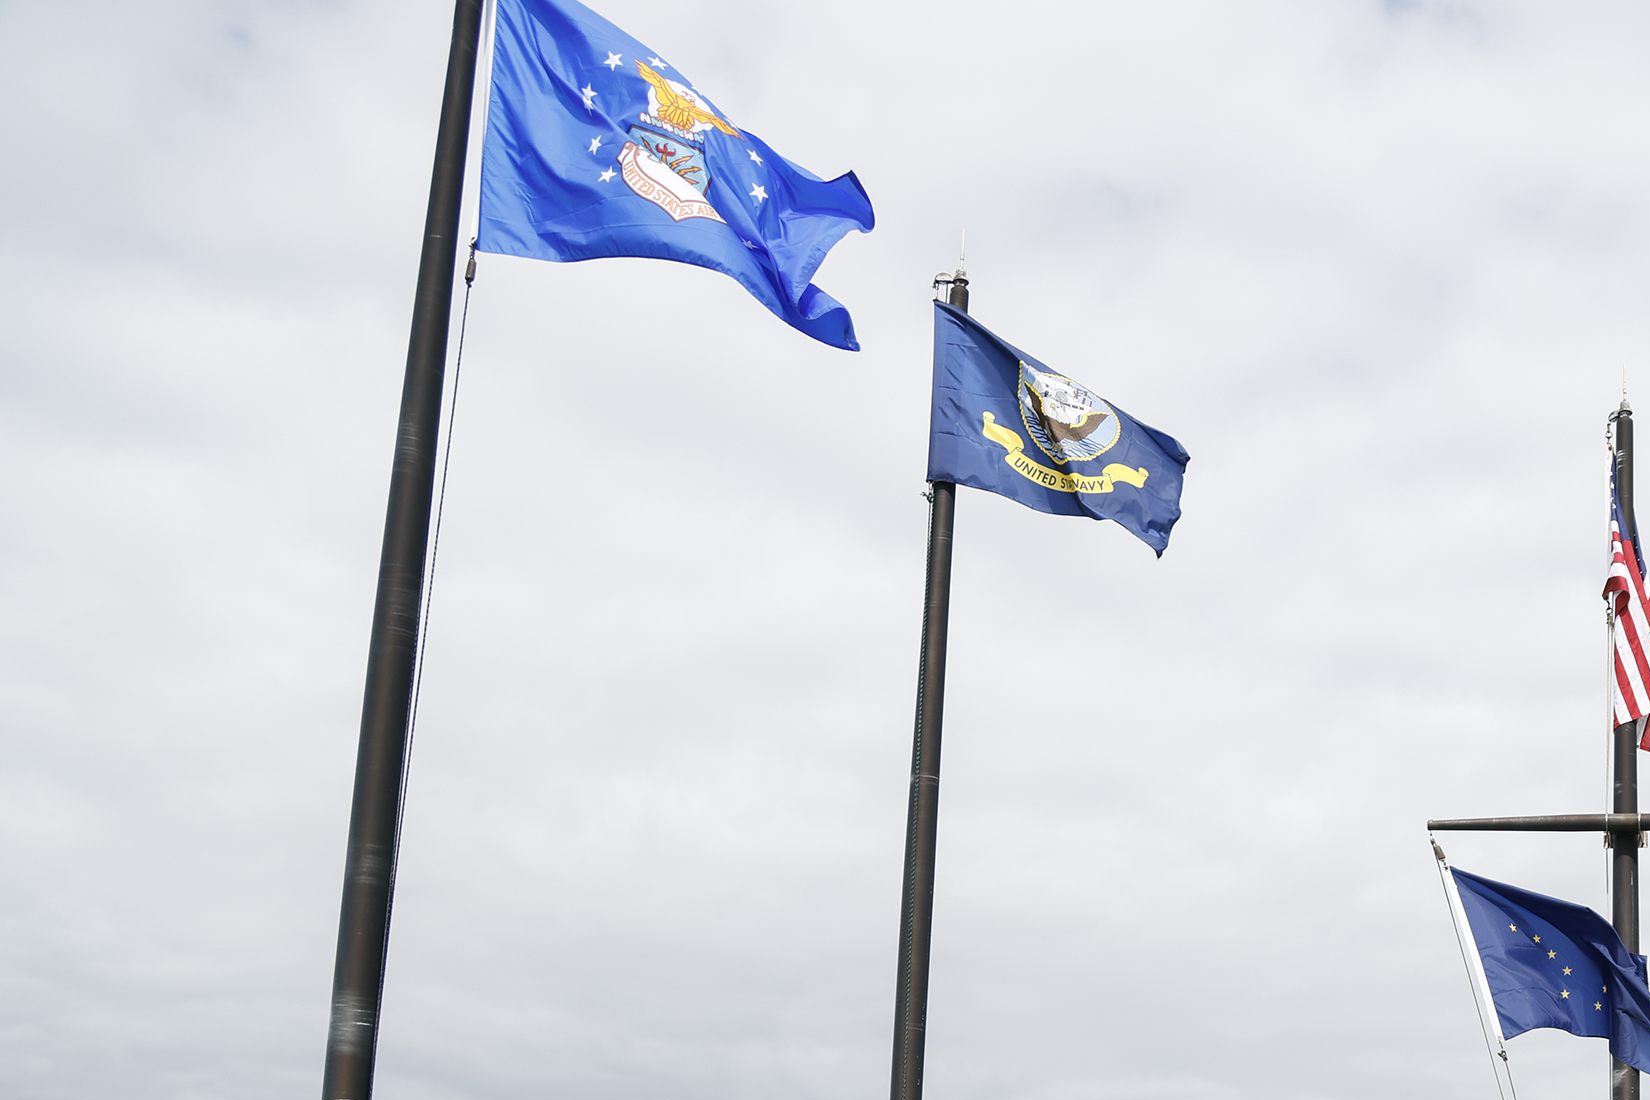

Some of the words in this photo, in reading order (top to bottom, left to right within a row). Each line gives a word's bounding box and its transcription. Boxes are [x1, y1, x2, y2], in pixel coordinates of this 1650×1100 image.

[623, 159, 655, 195] UNITED
[653, 189, 694, 217] STATES
[697, 205, 718, 218] AIR
[1014, 458, 1056, 486] UNITED
[1072, 479, 1104, 490] NAVY
